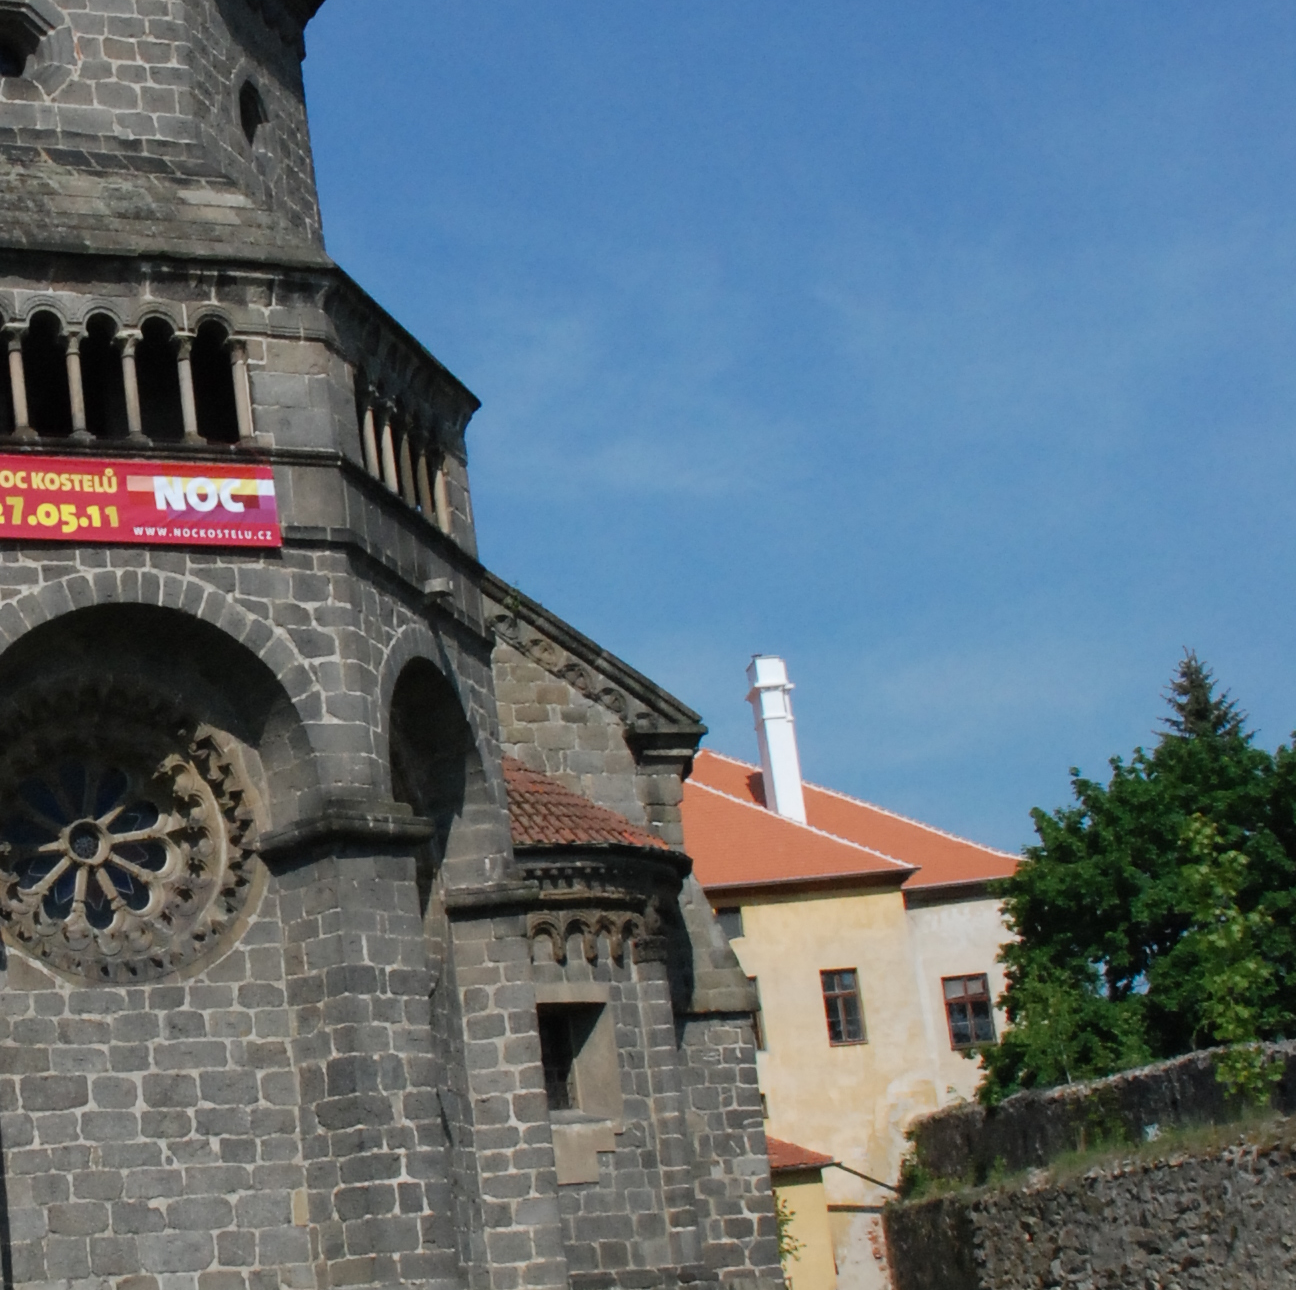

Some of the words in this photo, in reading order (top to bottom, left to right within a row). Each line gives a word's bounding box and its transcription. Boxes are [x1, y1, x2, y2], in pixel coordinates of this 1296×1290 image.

[31, 468, 118, 494] KOSTELŮ
[153, 475, 245, 513] NOC
[133, 526, 273, 540] WWW.NOCKOSTELU.CZ
